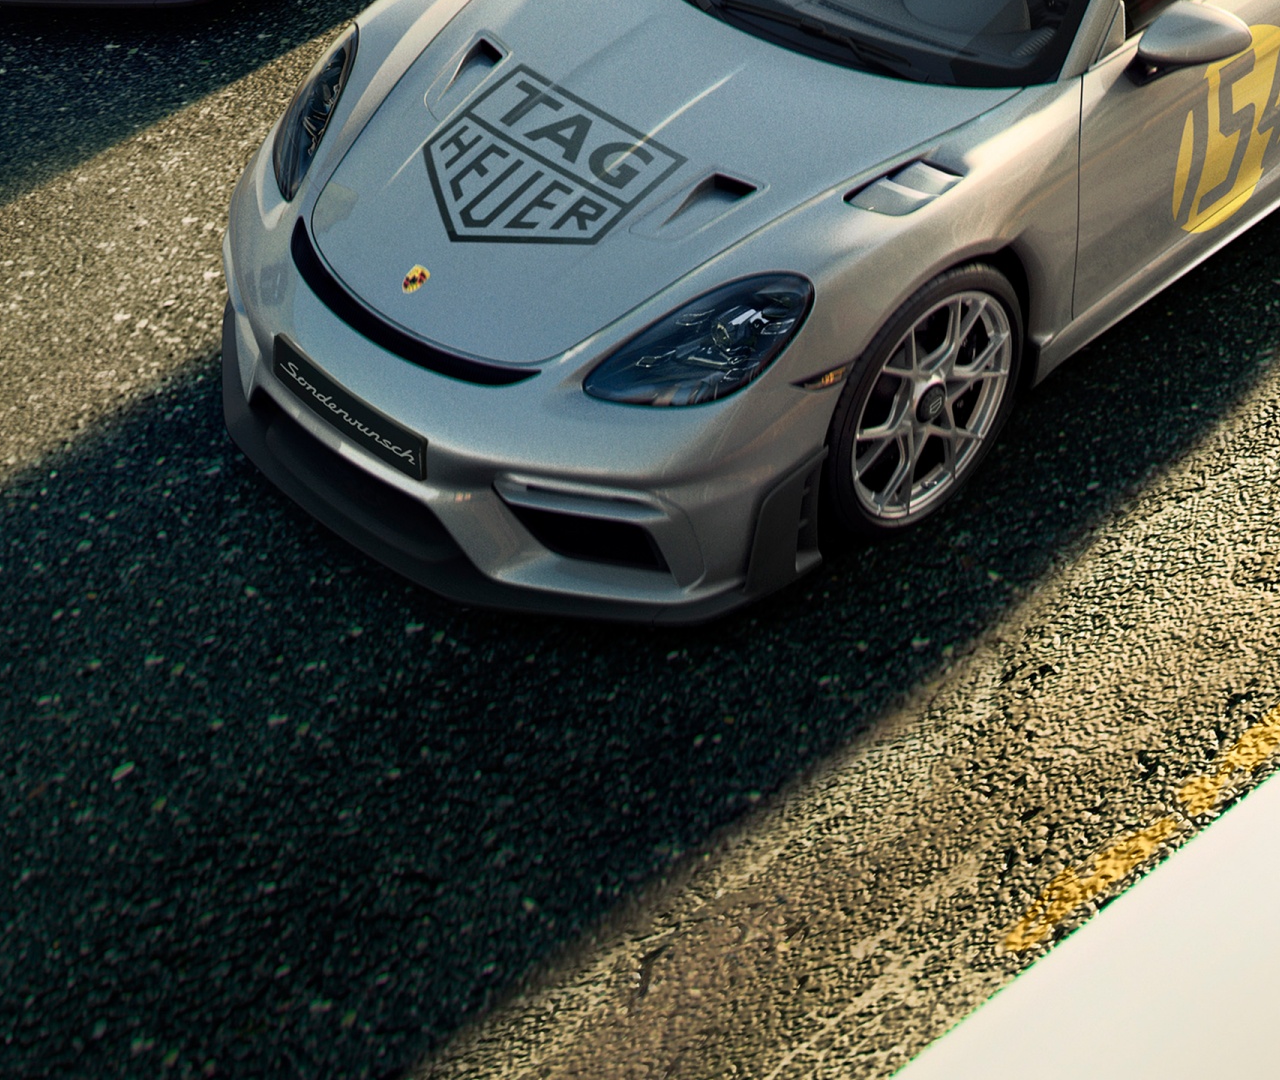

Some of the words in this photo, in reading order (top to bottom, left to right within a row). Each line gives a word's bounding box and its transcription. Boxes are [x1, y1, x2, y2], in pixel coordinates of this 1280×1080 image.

[440, 125, 608, 231] HEUER
[499, 80, 655, 189] TAG
[279, 361, 416, 465] Sonderwunsch
